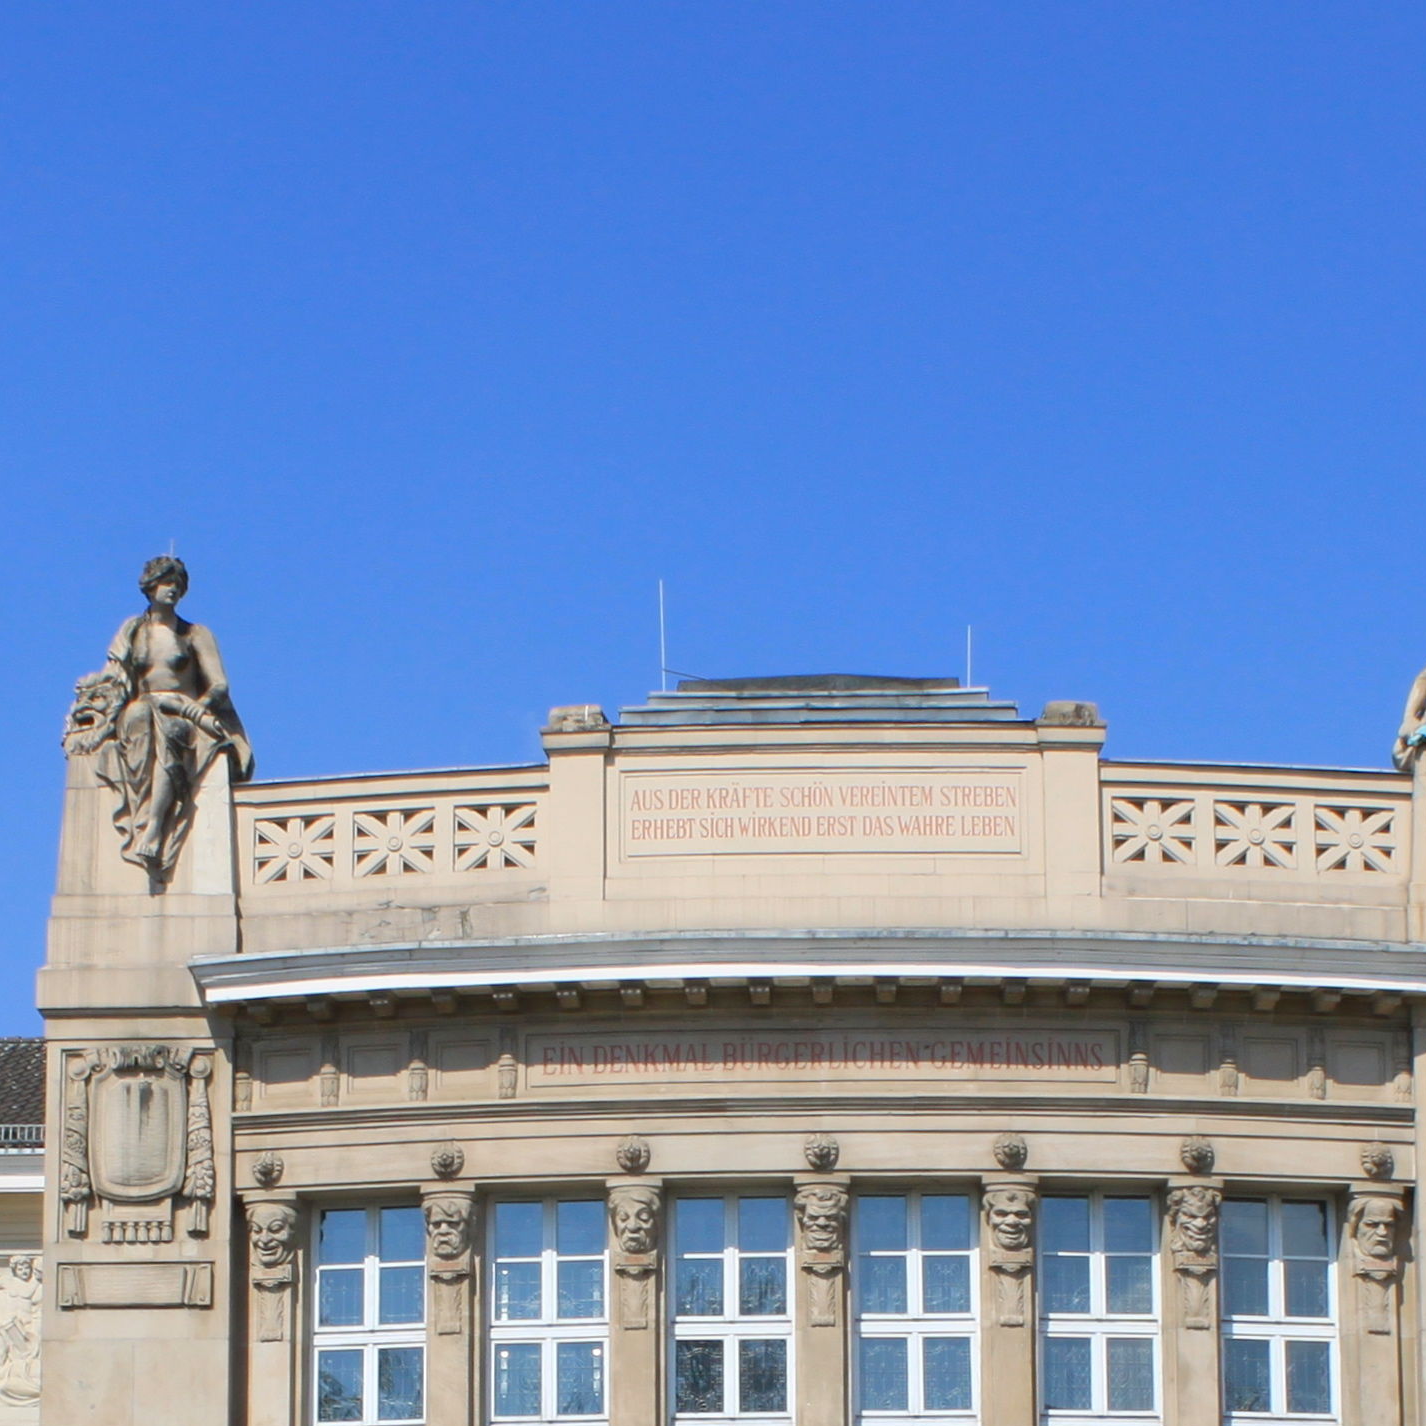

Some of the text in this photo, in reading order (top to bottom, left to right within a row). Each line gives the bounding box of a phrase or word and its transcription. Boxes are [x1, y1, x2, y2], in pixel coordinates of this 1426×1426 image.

[630, 789, 664, 811] AUS
[668, 788, 701, 810] DER
[707, 781, 774, 809] KRÄFTE
[779, 780, 834, 808] SCHÖN
[940, 785, 1017, 807] STREBEN
[631, 818, 696, 840] ERHEBT
[817, 815, 857, 837] ERST
[862, 815, 894, 837] DAS
[897, 815, 956, 837] WAHRE
[961, 815, 1016, 837] LEBEN
[592, 1043, 715, 1075] DENKMAL
